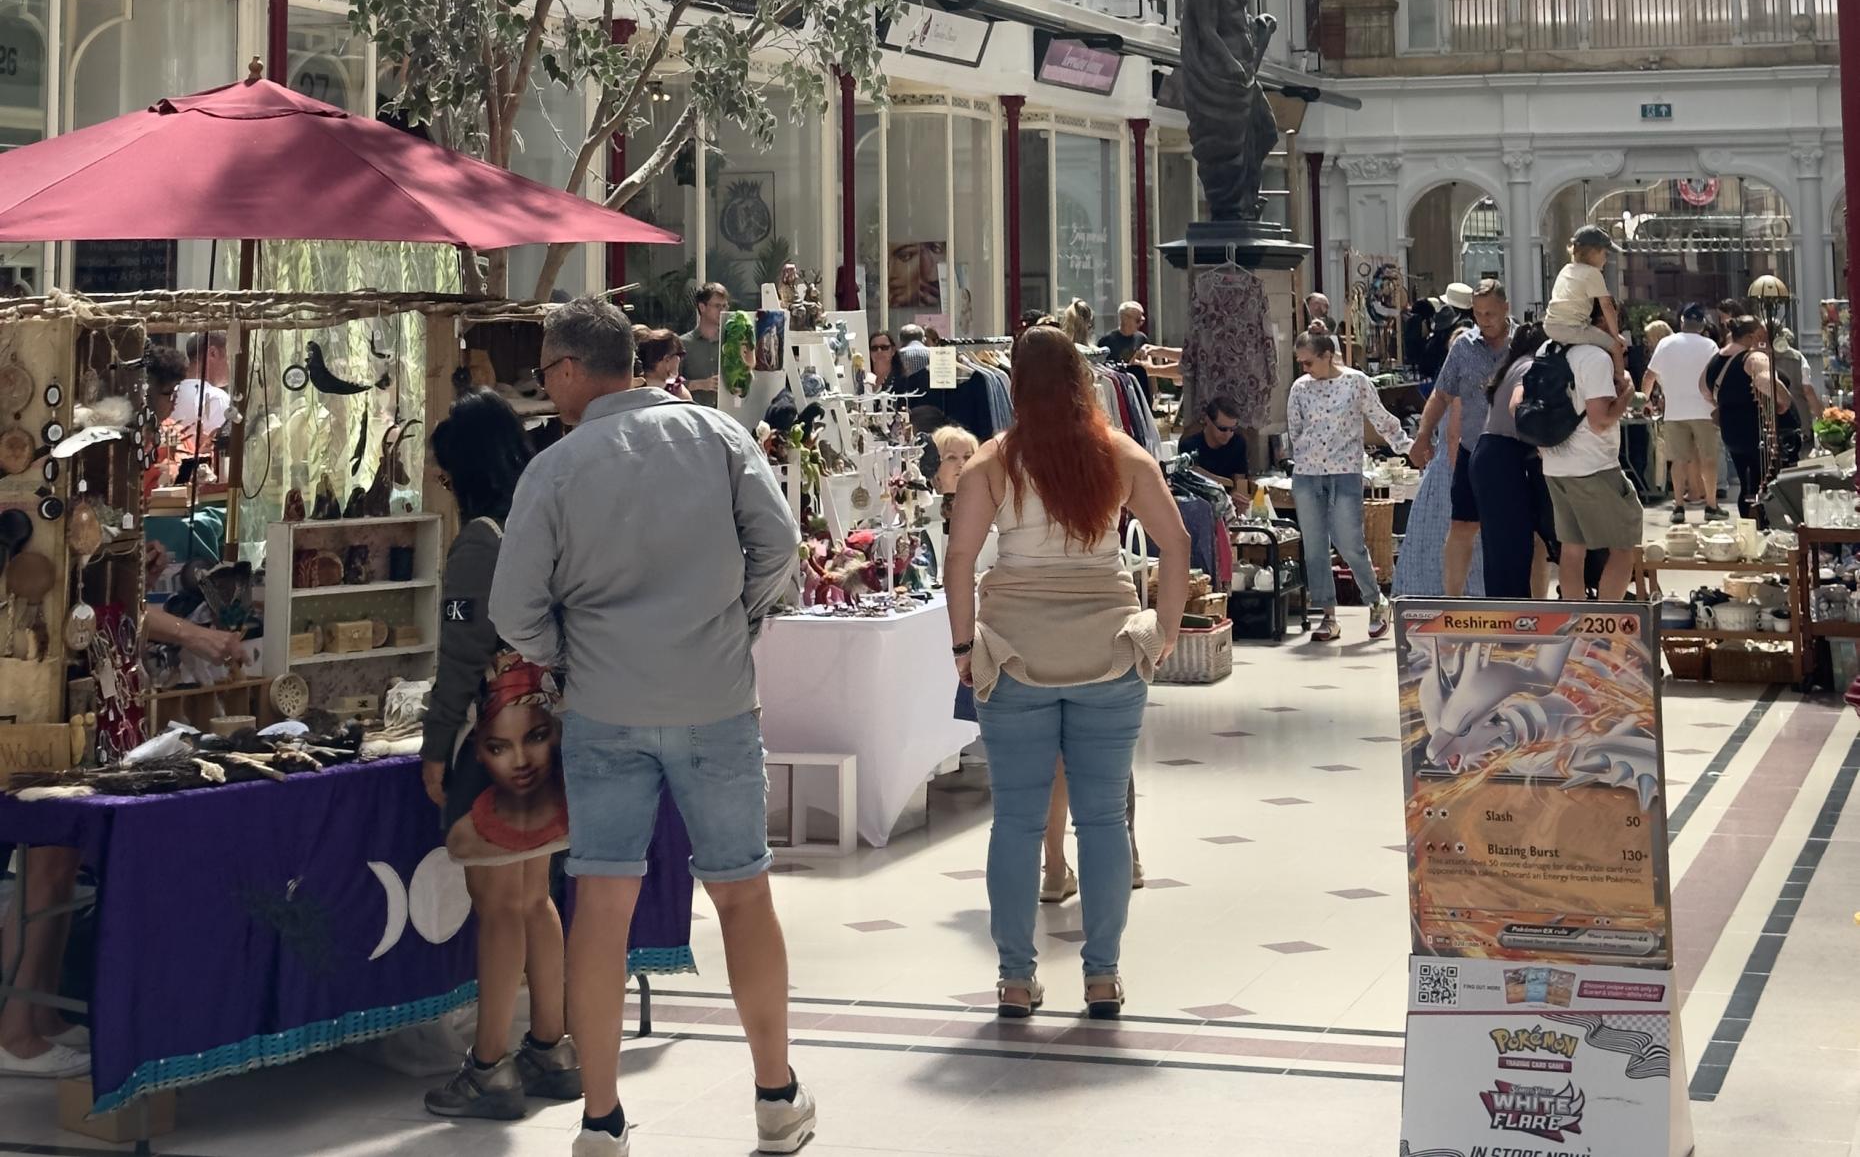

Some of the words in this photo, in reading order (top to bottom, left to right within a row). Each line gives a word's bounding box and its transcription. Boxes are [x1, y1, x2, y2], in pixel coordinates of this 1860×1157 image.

[1444, 615, 1512, 630] Reshiram
[1583, 617, 1617, 634] 230
[1485, 810, 1514, 822] Slash
[1625, 816, 1641, 828] 50
[1487, 843, 1527, 860] Blazing
[1529, 845, 1560, 858] Burst
[1543, 872, 1568, 883] Energy
[1505, 1059, 1530, 1068] TRADING
[1531, 1061, 1547, 1069] CARD
[1548, 1062, 1565, 1070] GAME
[1493, 1092, 1572, 1115] WHITE
[1491, 1111, 1562, 1130] FLARE
